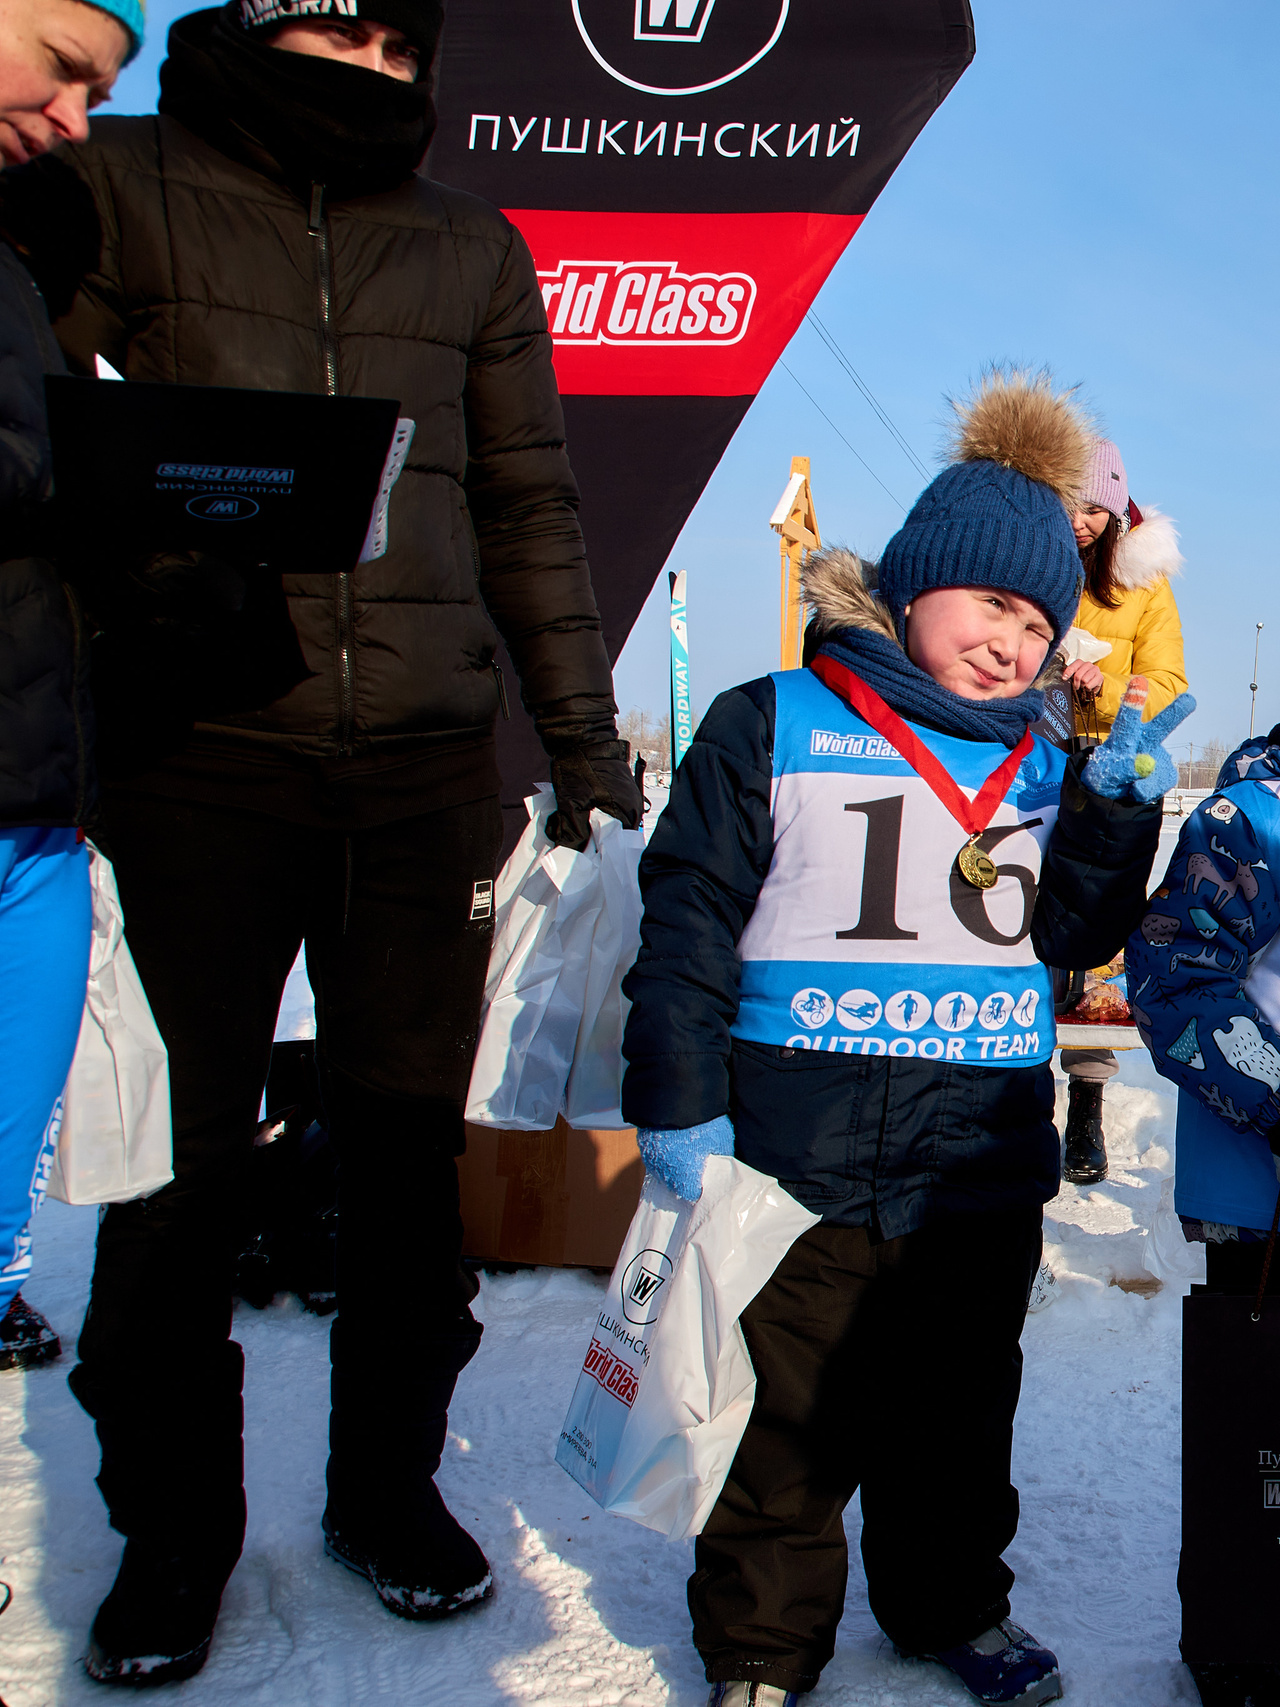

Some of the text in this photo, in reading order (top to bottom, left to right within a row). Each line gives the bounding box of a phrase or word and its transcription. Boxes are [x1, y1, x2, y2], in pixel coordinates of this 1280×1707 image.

[468, 114, 861, 158] ПУШКИНСКИЙ
[541, 271, 746, 335] rld Class
[161, 464, 290, 483] World Class
[674, 657, 692, 753] NORDWAY
[813, 731, 866, 757] World
[835, 793, 1044, 947] 16
[976, 1031, 1040, 1060] TEAM
[633, 1272, 658, 1301] W
[584, 1347, 639, 1404] orld Clas
